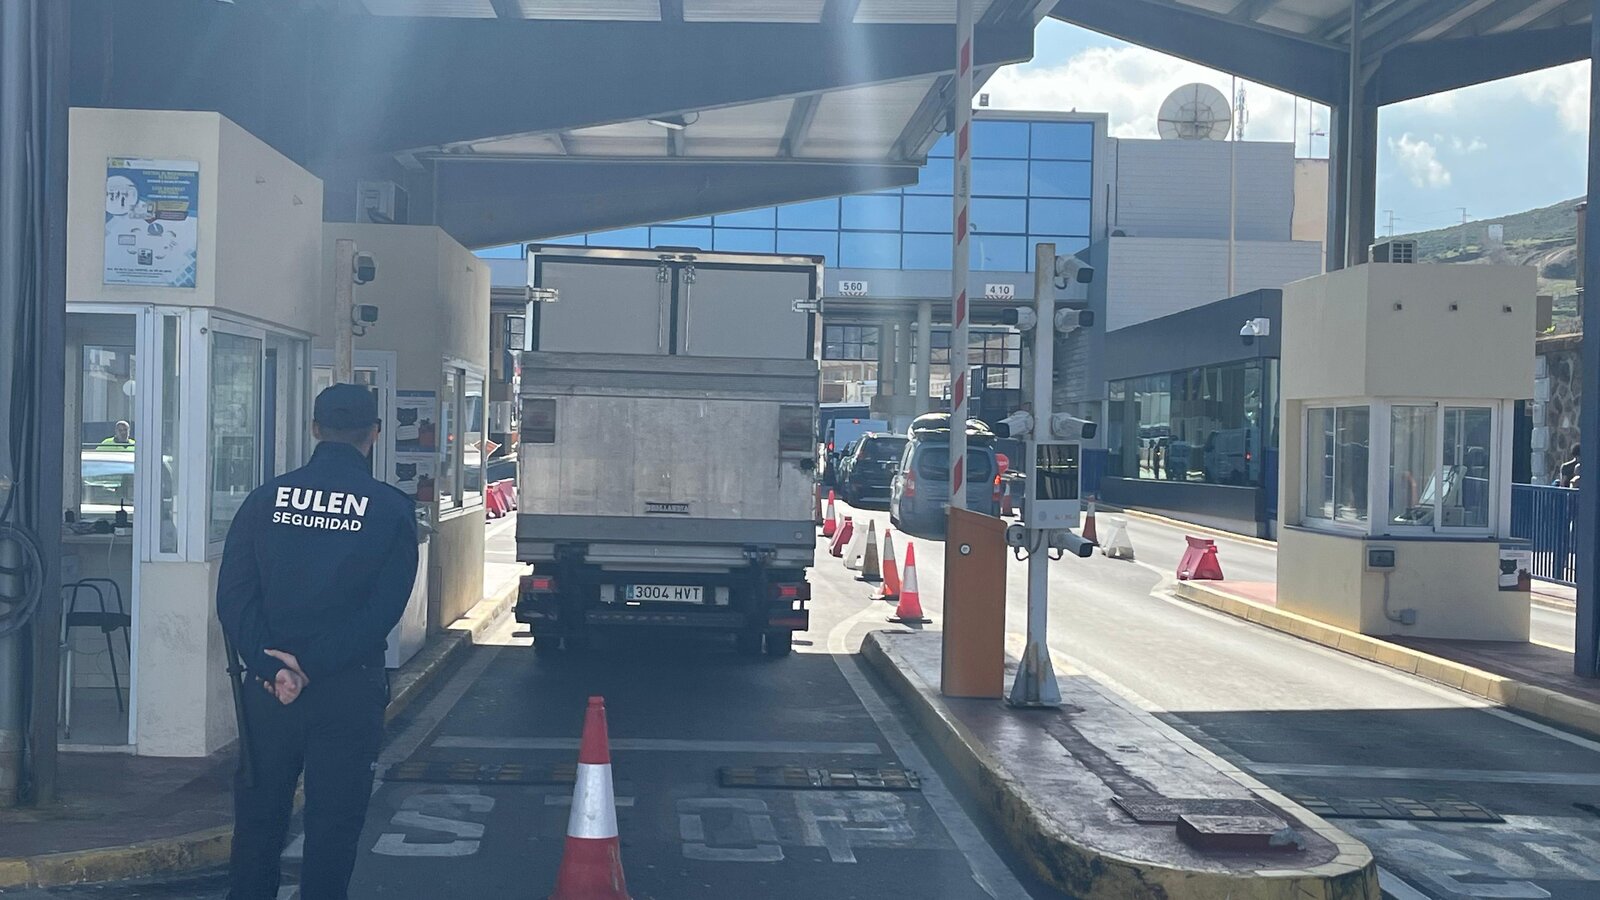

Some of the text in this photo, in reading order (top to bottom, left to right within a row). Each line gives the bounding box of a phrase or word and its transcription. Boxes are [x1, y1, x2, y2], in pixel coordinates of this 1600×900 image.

[275, 487, 368, 516] EULEN
[272, 511, 362, 531] SEGURIDAD
[636, 586, 700, 600] 3004 HVT
